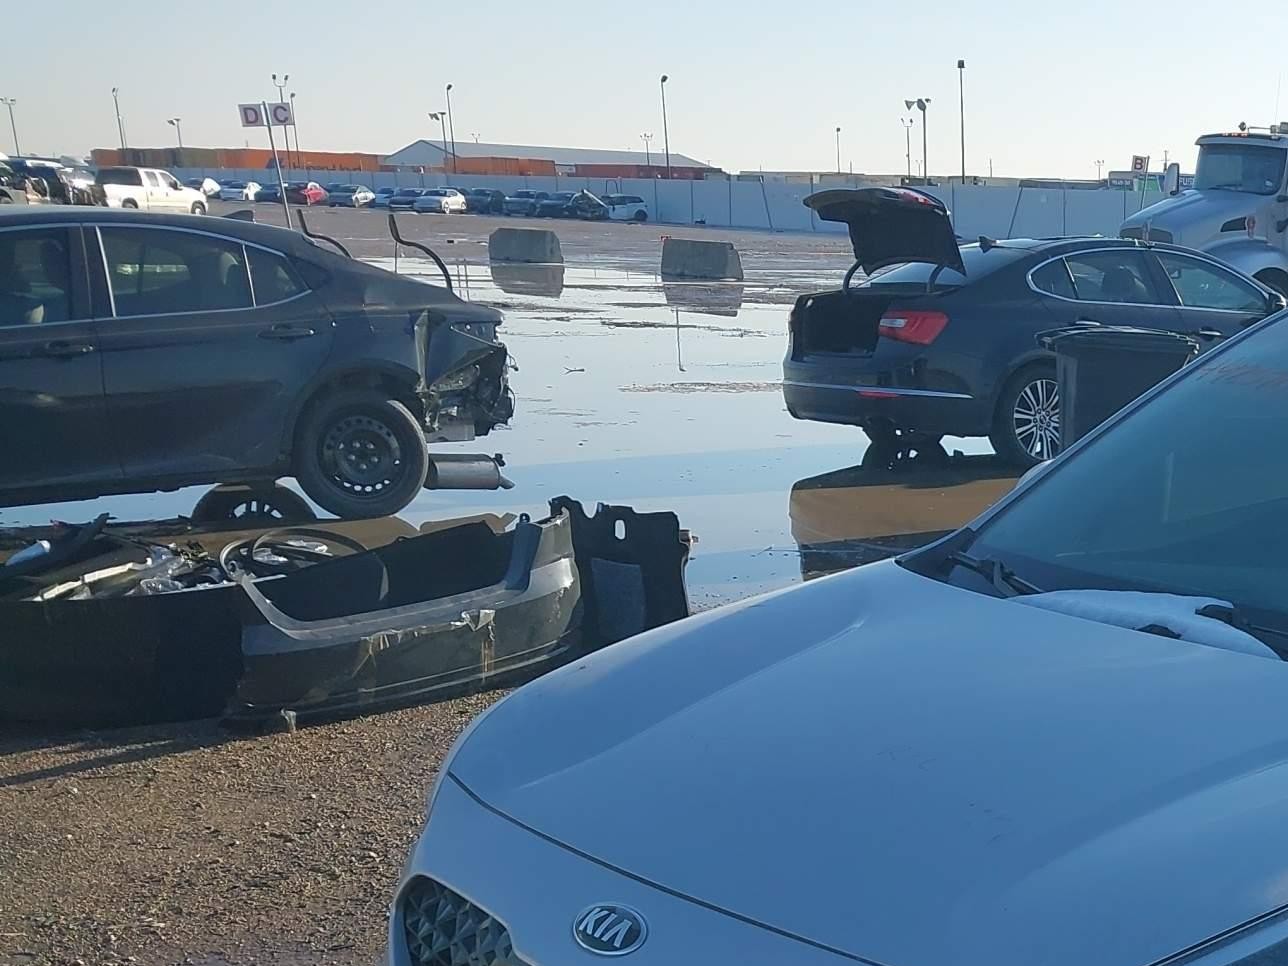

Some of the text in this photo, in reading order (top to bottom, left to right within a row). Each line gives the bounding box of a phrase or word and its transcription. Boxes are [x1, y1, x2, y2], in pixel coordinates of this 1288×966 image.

[242, 107, 259, 124] D
[273, 105, 289, 123] C
[1134, 157, 1143, 170] B
[578, 907, 632, 948] KIA
